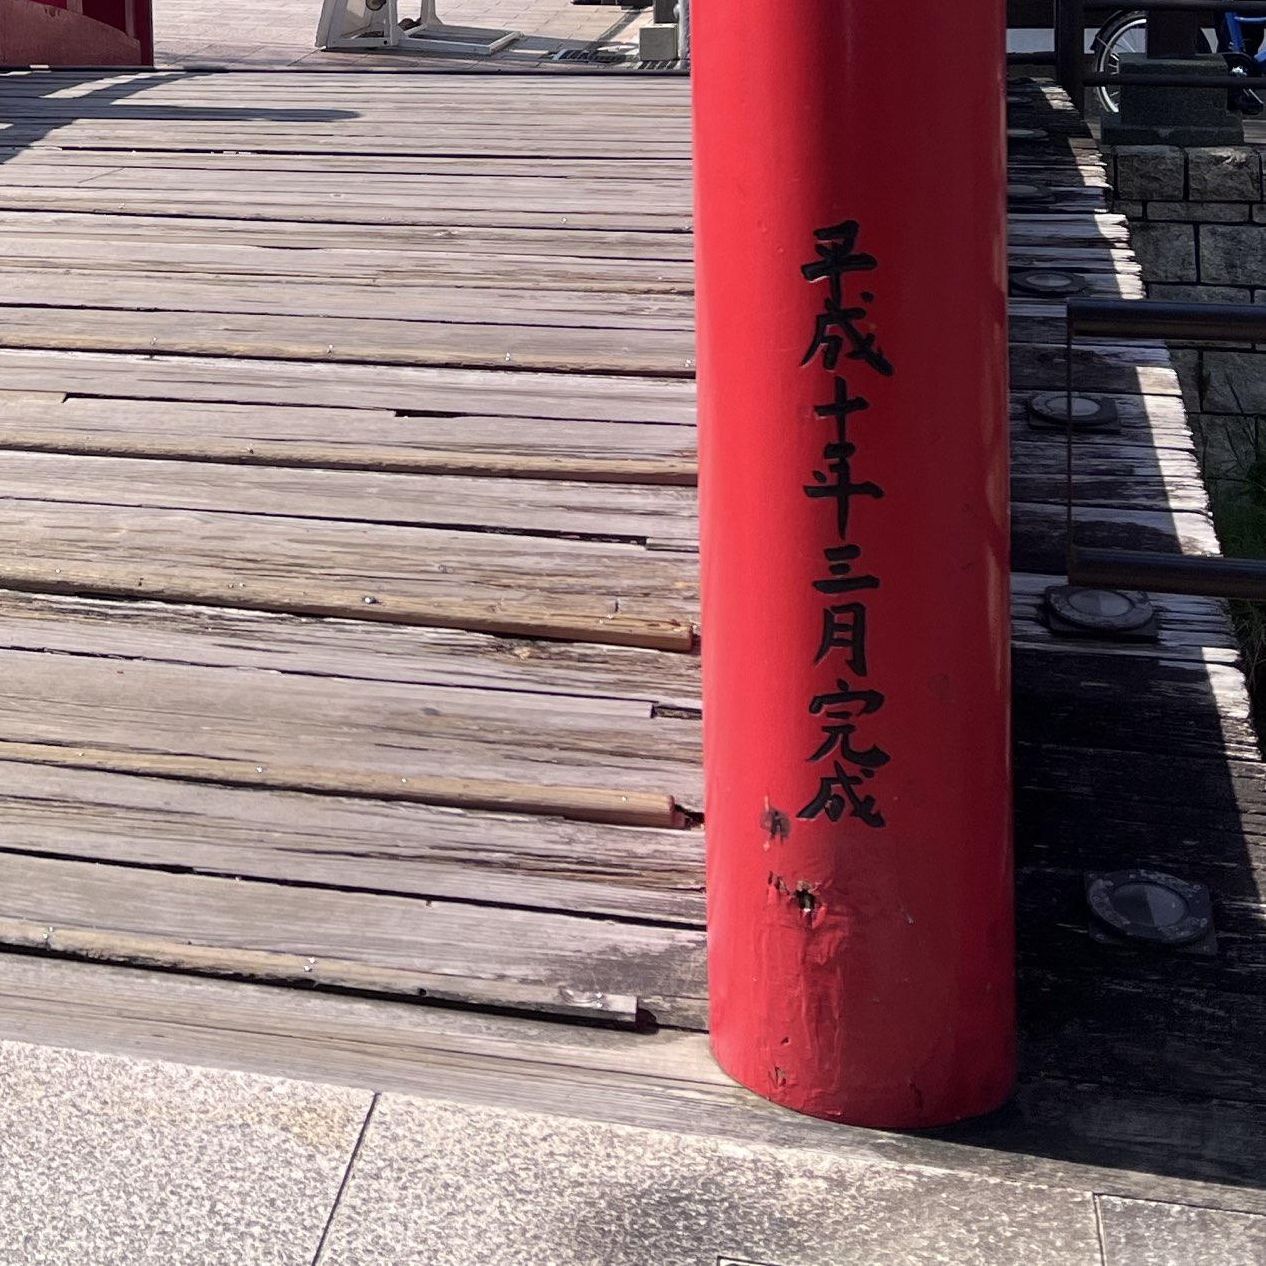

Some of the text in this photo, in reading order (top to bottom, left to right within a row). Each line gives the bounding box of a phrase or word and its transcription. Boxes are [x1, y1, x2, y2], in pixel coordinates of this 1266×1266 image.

[795, 219, 895, 829] 平成十年三月完成
